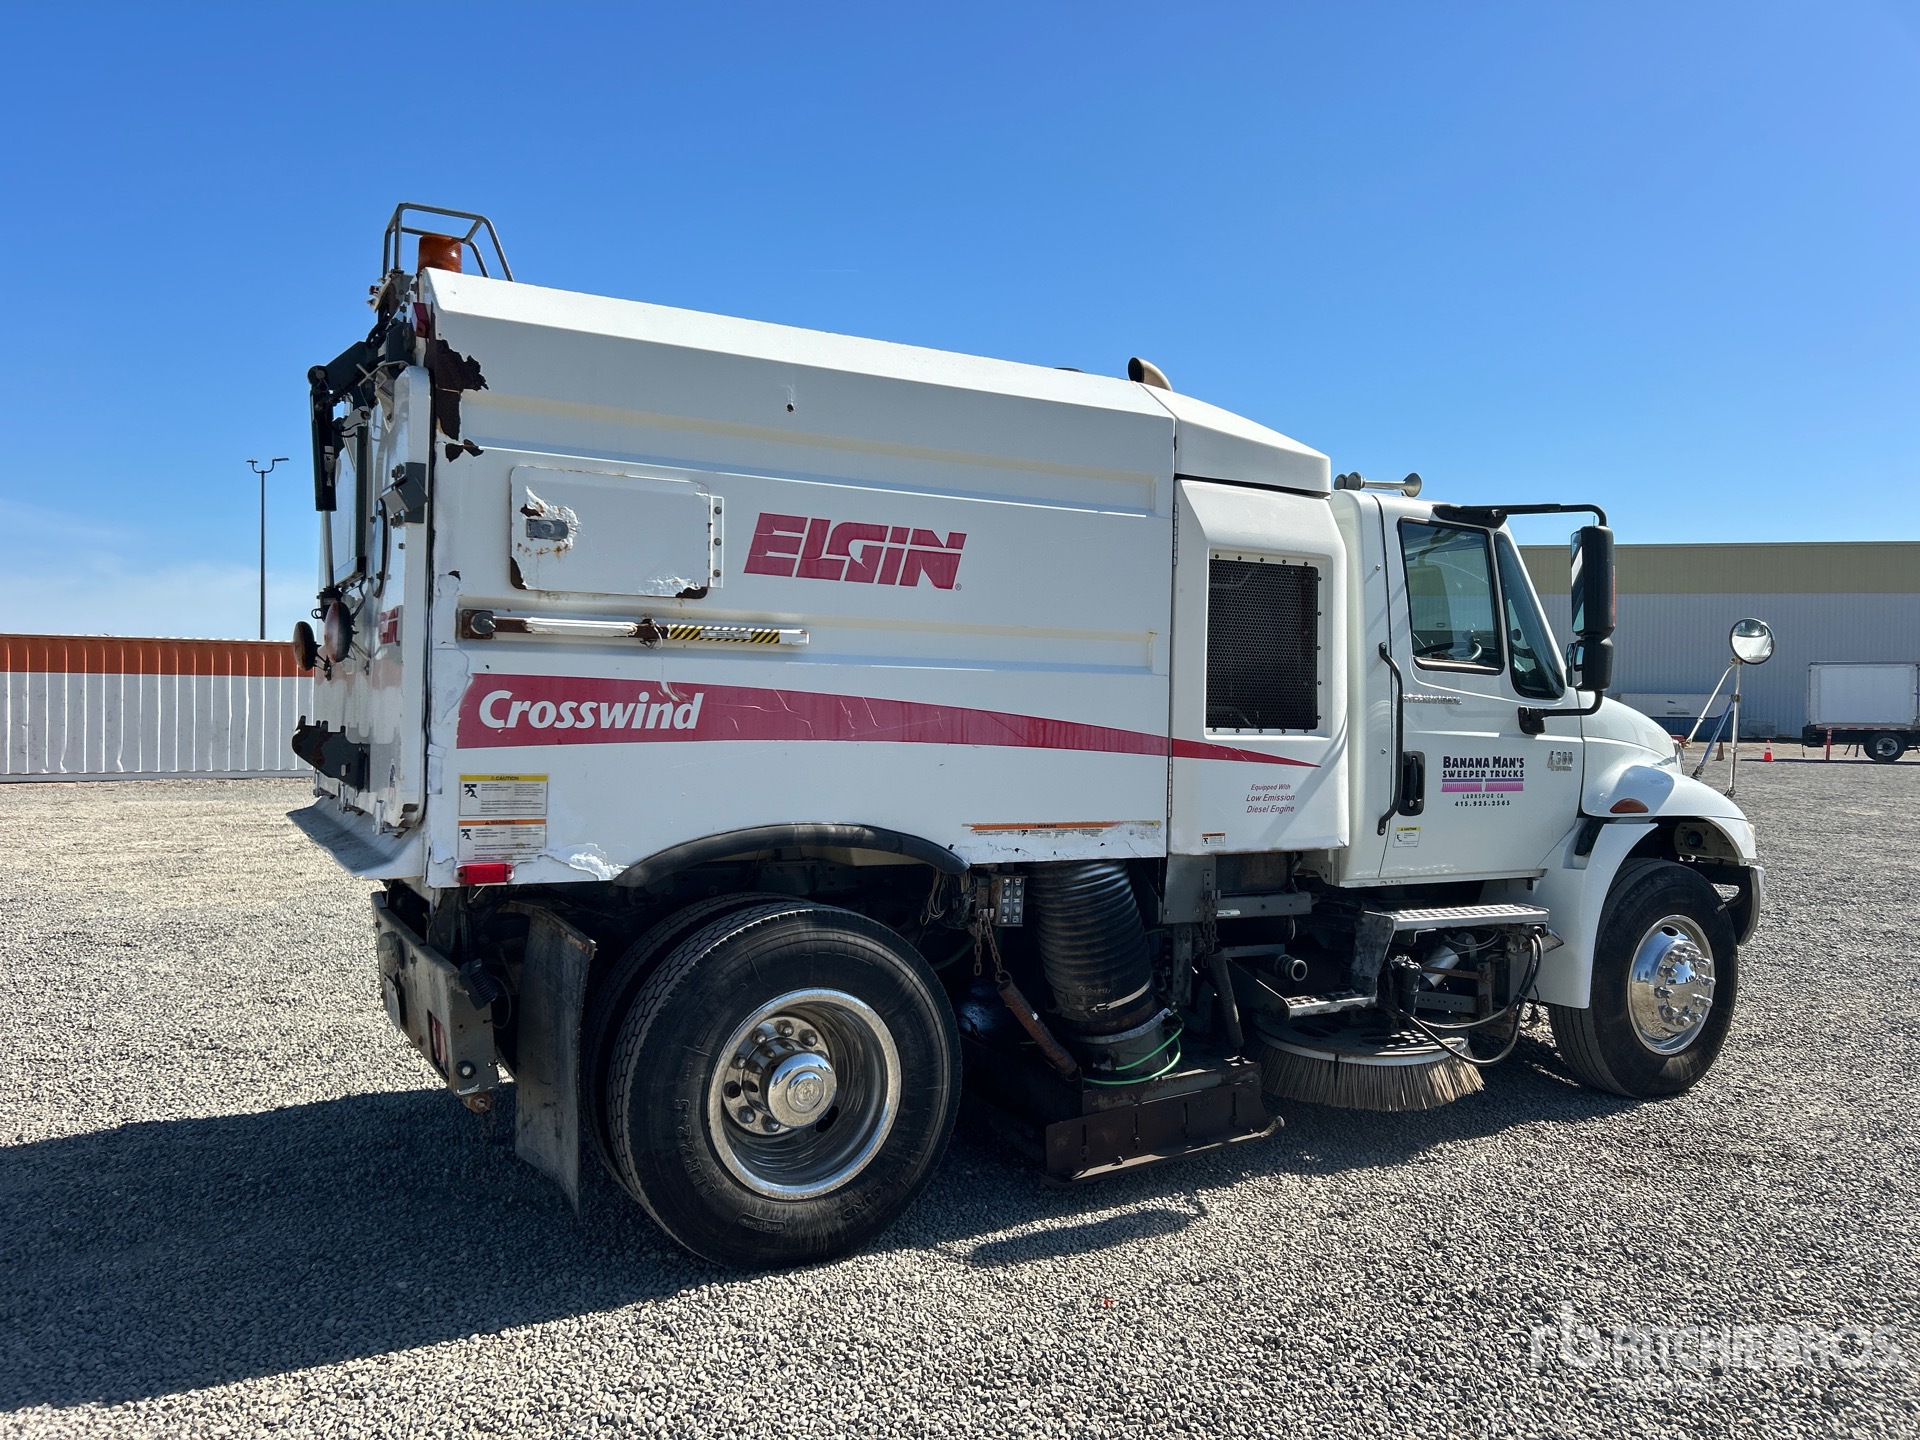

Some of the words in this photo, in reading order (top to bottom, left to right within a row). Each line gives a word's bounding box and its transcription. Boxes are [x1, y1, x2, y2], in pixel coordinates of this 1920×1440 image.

[743, 512, 967, 590] ELGIN
[478, 689, 704, 730] Crosswind
[1443, 756, 1490, 769] BANANA
[1492, 756, 1525, 769] MAN'S
[1442, 770, 1487, 778] SWEEPER
[1490, 769, 1525, 778] TRUCKS
[1250, 783, 1278, 792] Equipped
[1246, 794, 1262, 802] Low
[1262, 793, 1296, 802] Emission
[1246, 805, 1270, 813] Diesel
[1269, 805, 1295, 815] Engine
